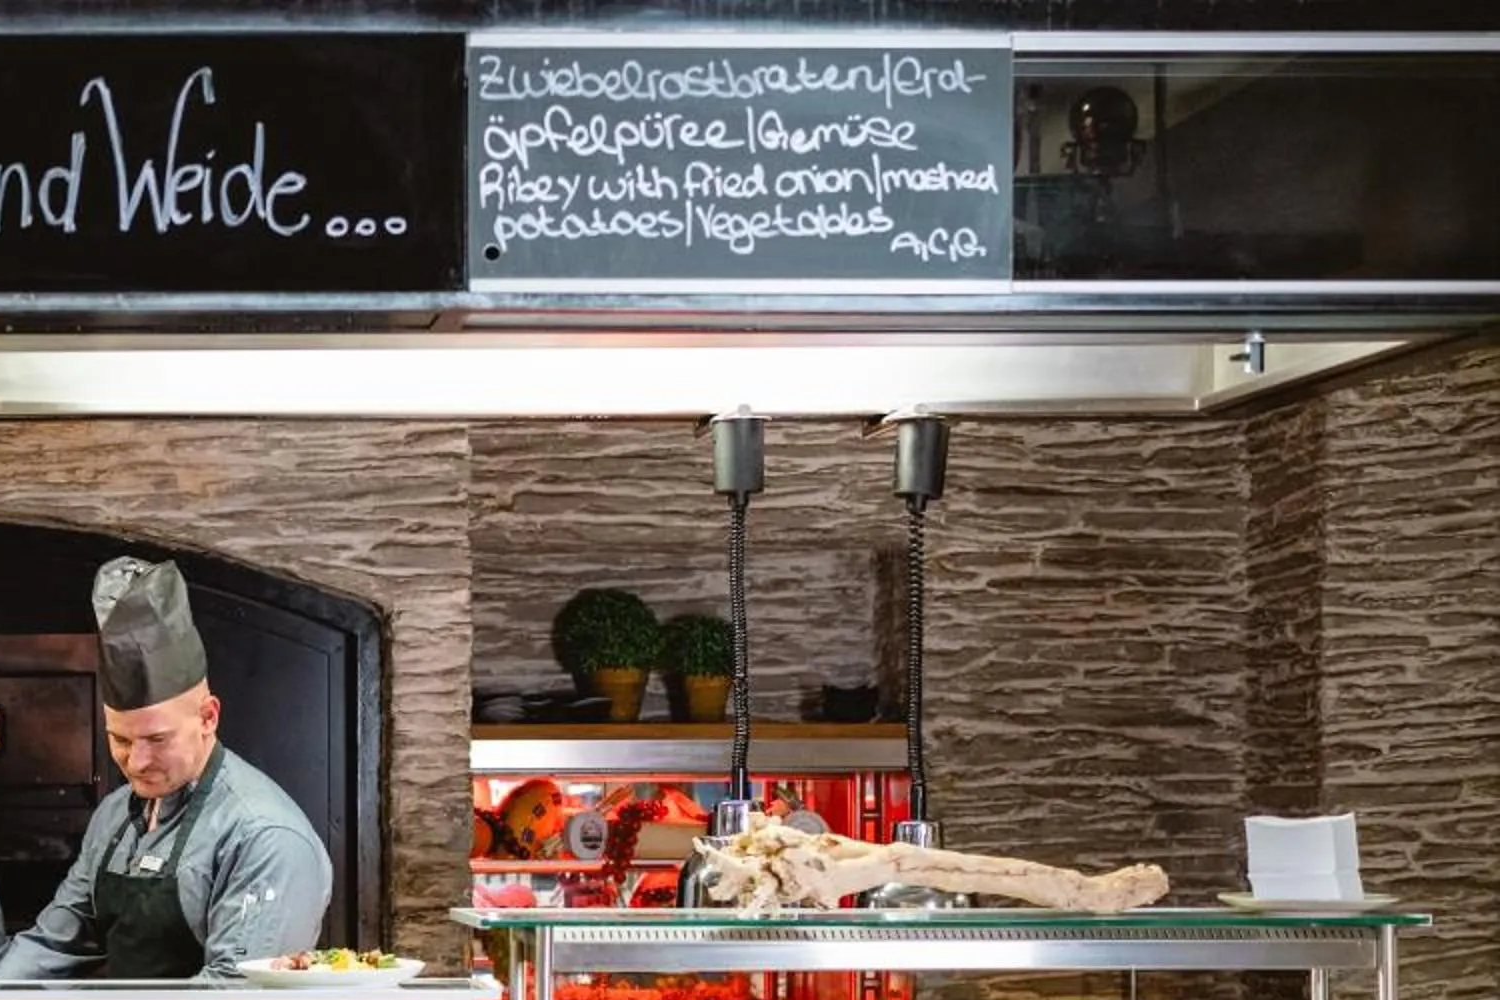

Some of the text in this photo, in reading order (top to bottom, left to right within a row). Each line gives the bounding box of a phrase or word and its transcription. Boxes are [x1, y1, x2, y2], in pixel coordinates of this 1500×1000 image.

[479, 161, 580, 212] Ribey
[587, 163, 678, 202] with
[683, 160, 768, 198] fried
